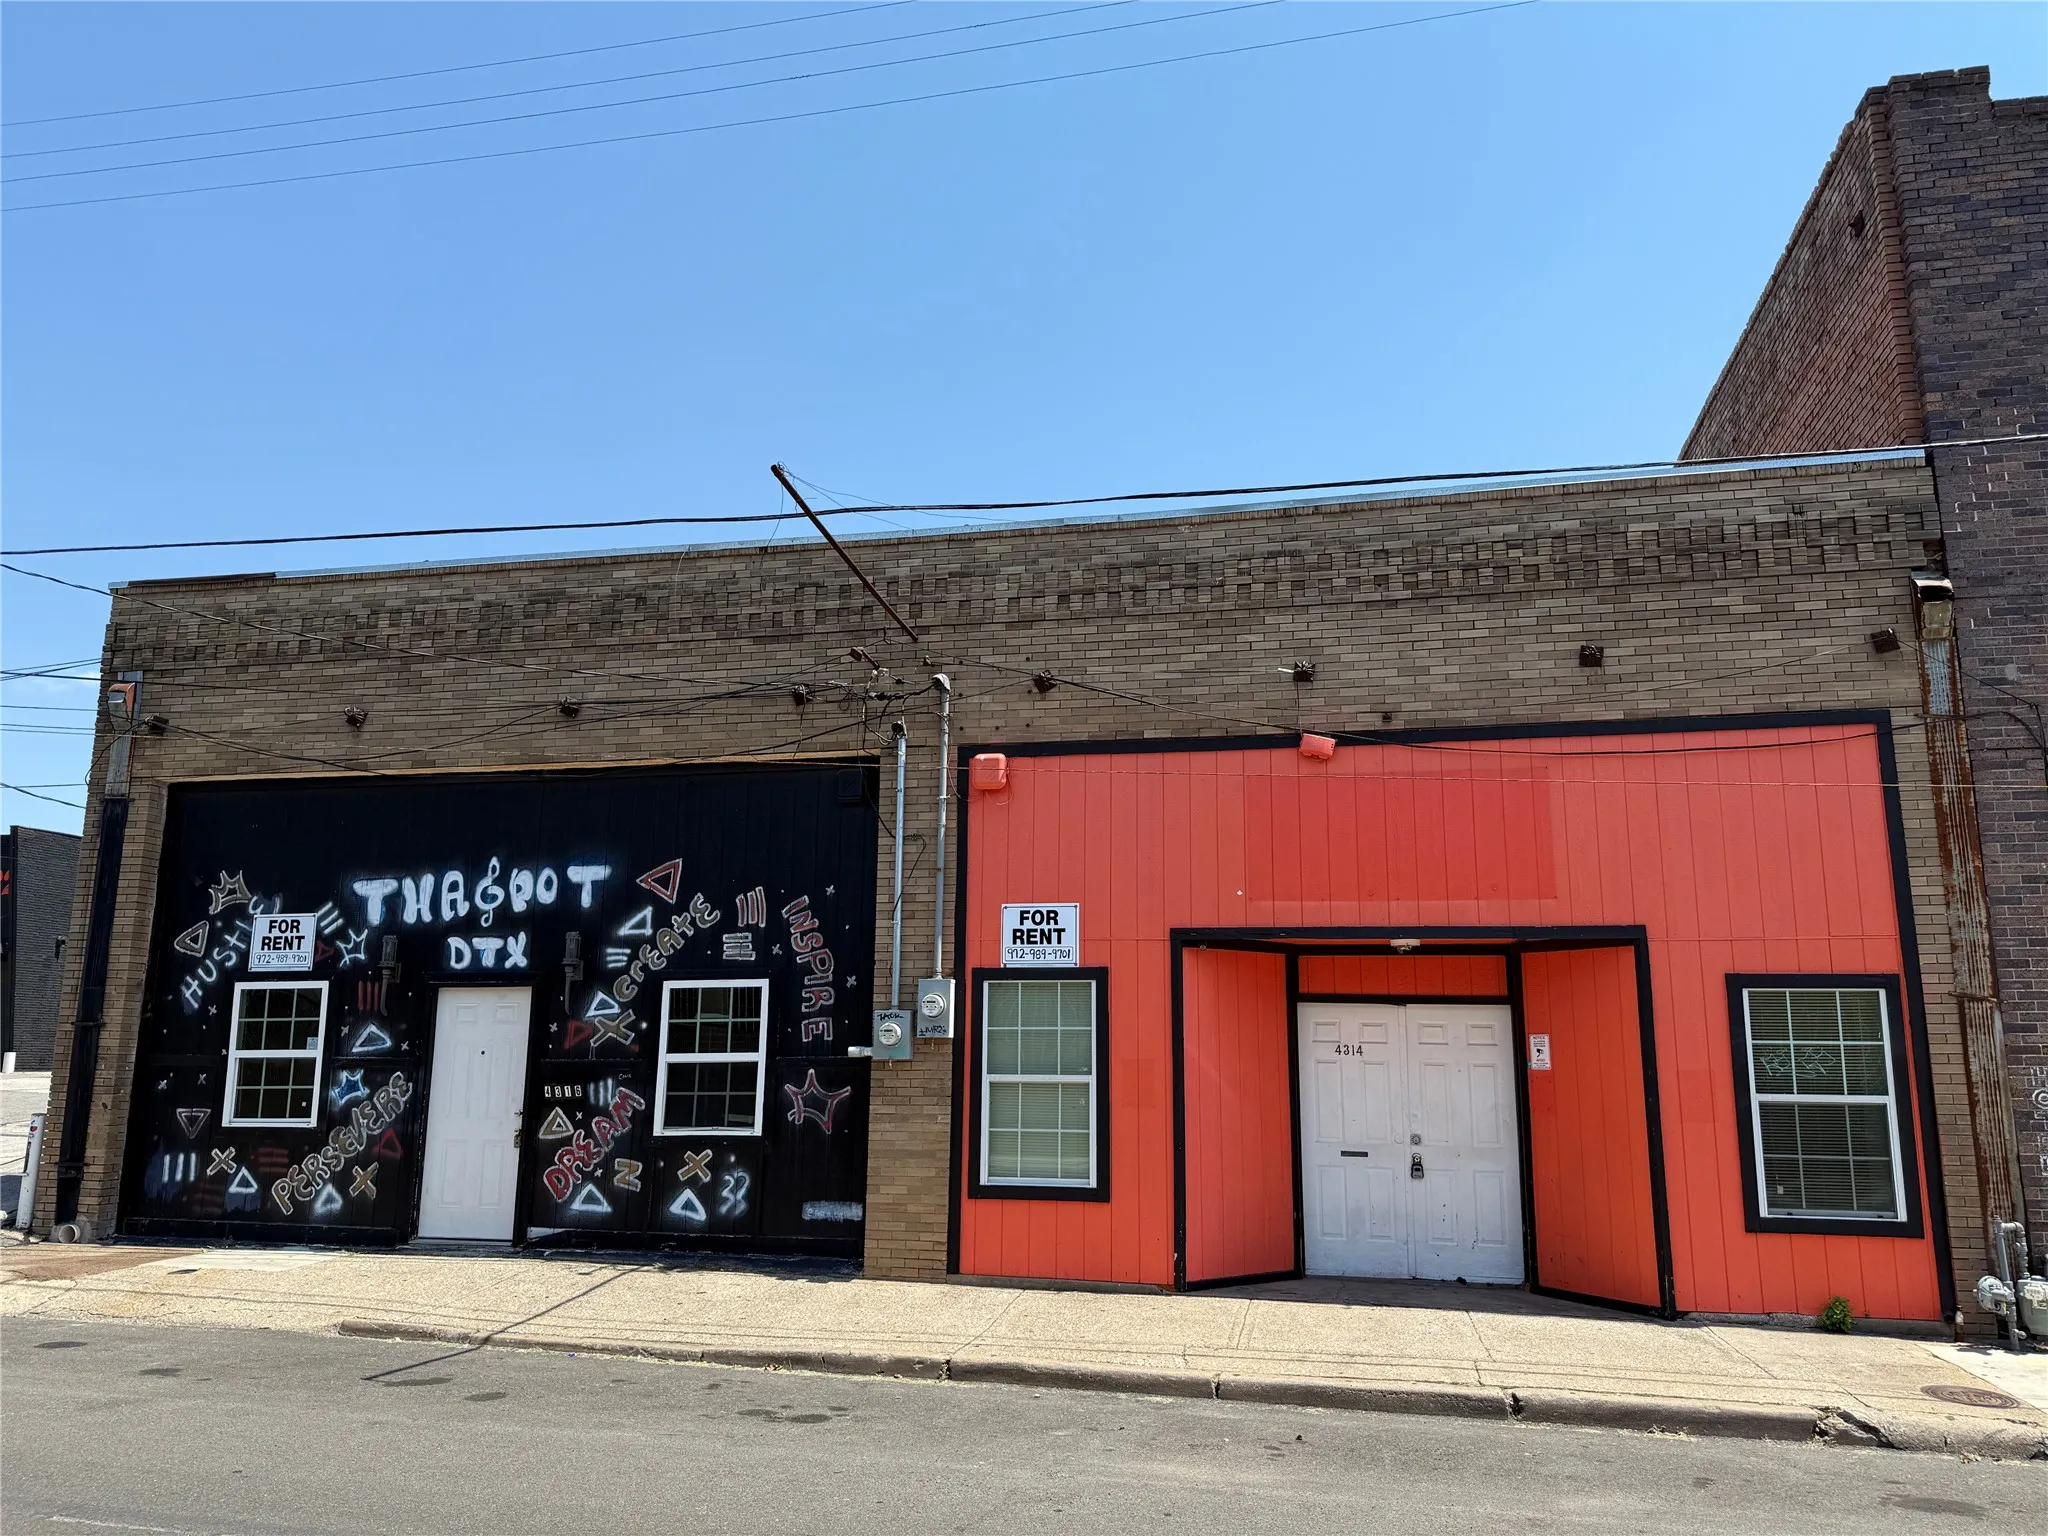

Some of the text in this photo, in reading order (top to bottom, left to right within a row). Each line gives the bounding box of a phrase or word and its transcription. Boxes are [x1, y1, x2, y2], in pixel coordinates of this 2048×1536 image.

[1019, 909, 1059, 926] FOR
[268, 919, 301, 934] FOR
[261, 935, 305, 951] RENT
[1012, 928, 1066, 945] RENT
[447, 931, 527, 969] DTX
[1007, 948, 1071, 960] 972-989-9701
[781, 895, 835, 1042] INSPIRE
[1334, 1044, 1364, 1056] 4314
[544, 1085, 582, 1097] 4316
[271, 1072, 413, 1215] PERSEVERE
[543, 1086, 646, 1202] DREAM
